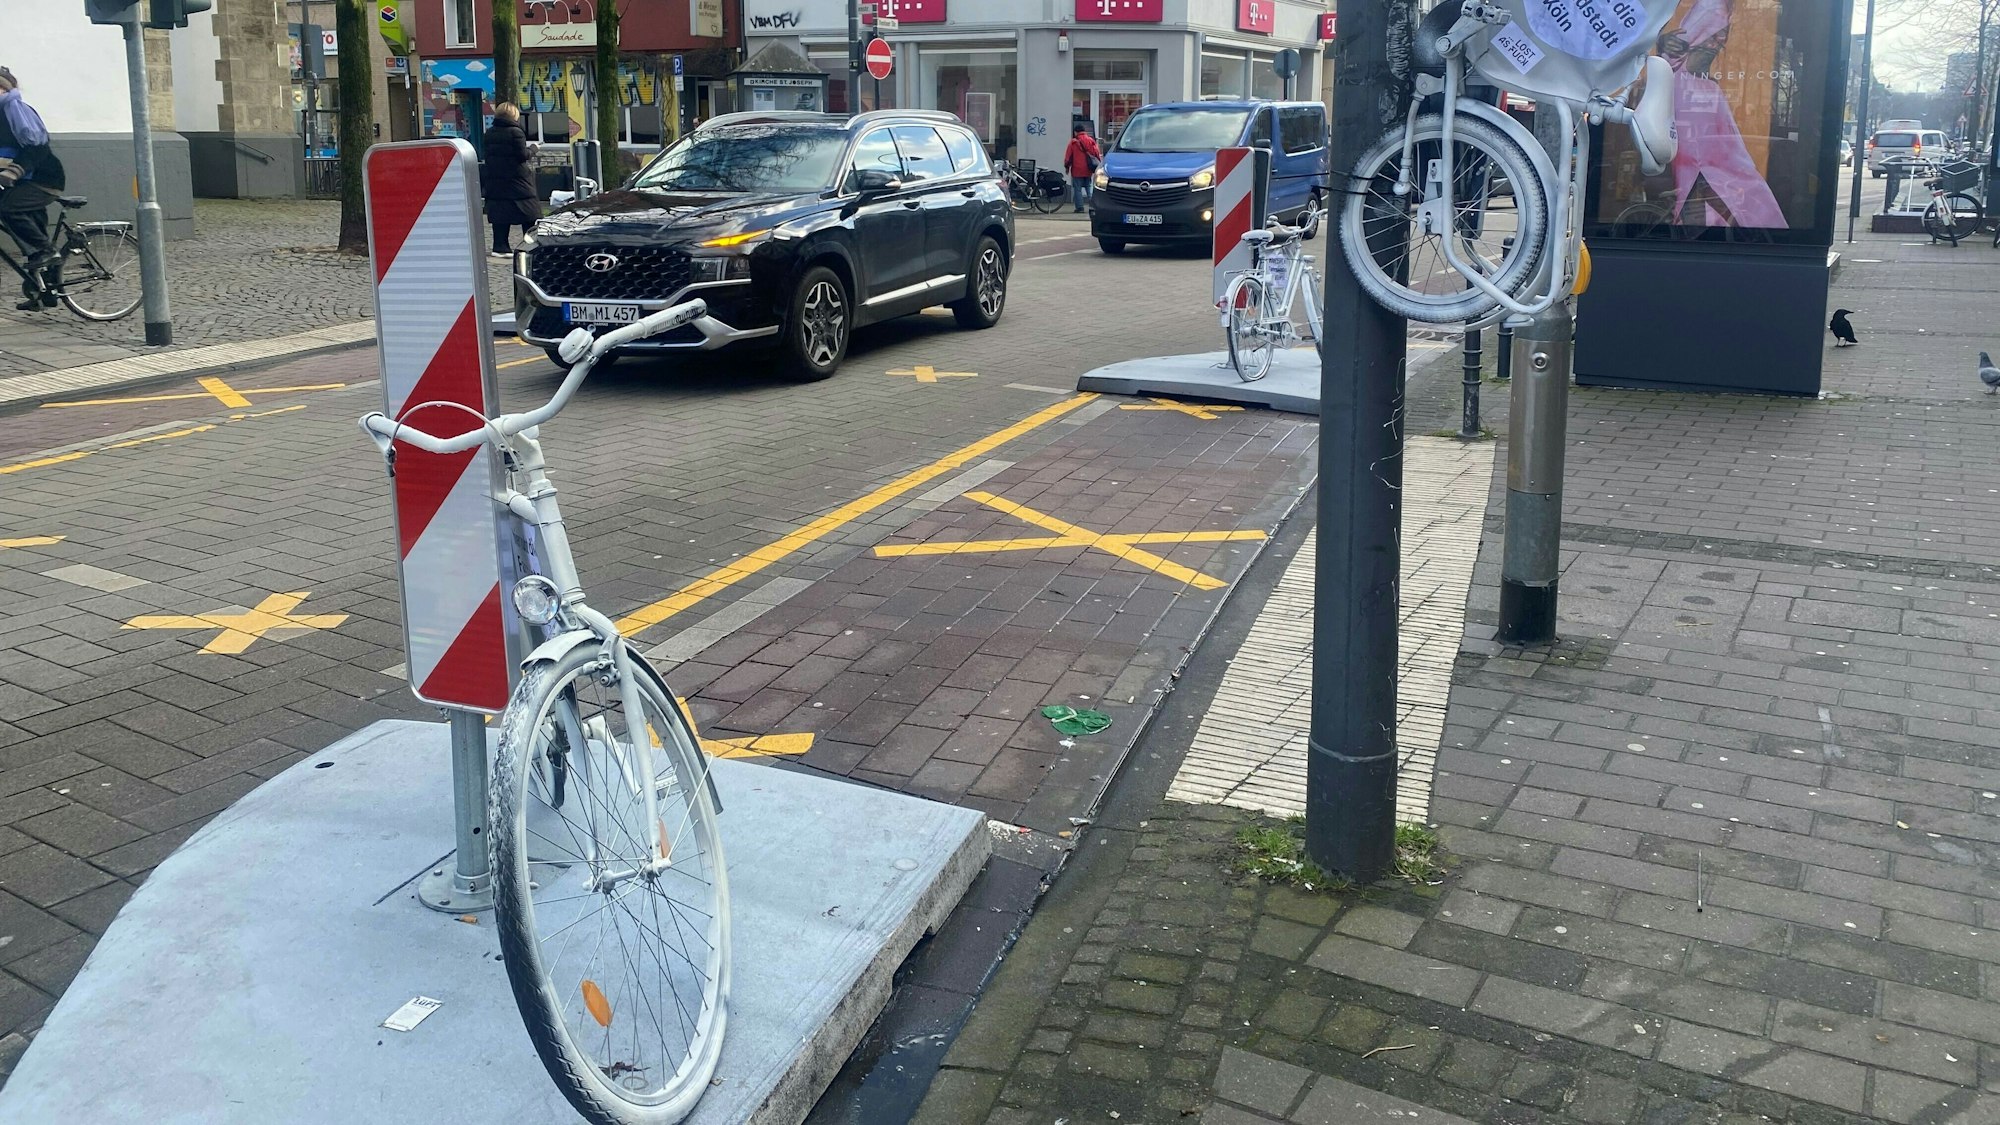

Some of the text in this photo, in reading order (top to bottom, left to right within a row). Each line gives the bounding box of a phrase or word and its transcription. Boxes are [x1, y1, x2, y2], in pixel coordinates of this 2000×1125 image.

[1575, 0, 1619, 49] dstadt
[1613, 2, 1637, 28] die
[536, 26, 584, 45] Saudade
[1498, 36, 1529, 67] AS FUCK
[1515, 39, 1536, 60] LOST
[1673, 70, 1795, 80] NINGER.COM
[1140, 215, 1148, 223] ZA
[1150, 215, 1162, 223] 415
[571, 306, 637, 321] BM MI 457
